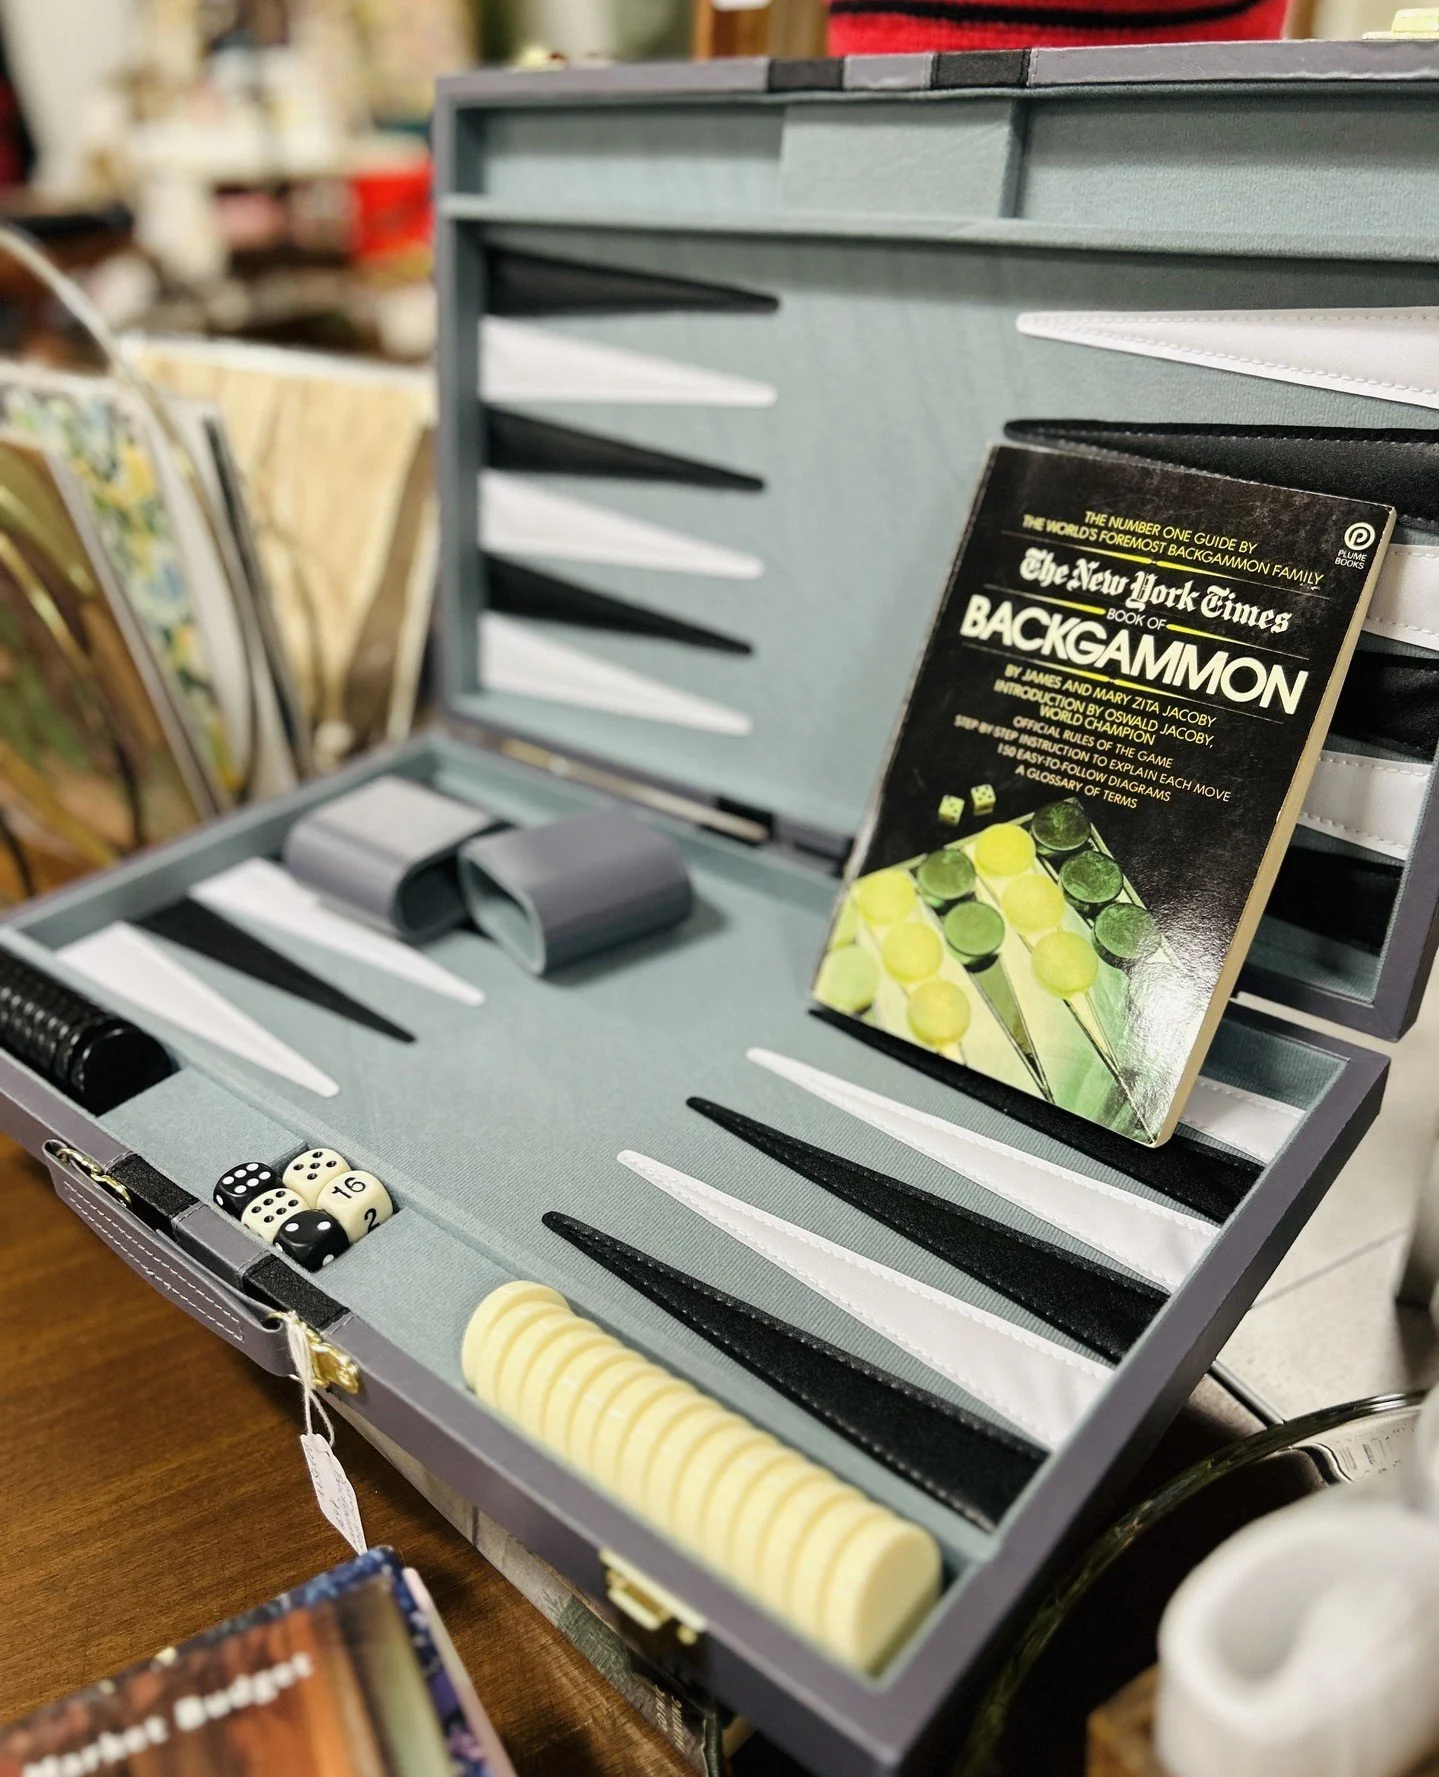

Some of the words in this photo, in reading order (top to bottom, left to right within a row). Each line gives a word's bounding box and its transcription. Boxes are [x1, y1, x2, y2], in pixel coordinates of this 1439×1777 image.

[1022, 514, 1046, 531] THE
[1046, 519, 1098, 542] WORLD'S
[1099, 530, 1167, 554] FOREMOST
[1168, 544, 1271, 576] BACKGAMMON
[1272, 564, 1325, 586] FAMILY
[1084, 511, 1107, 527] THE
[1108, 516, 1161, 536] NUMBER
[1163, 526, 1192, 543] ONE
[1194, 532, 1237, 551] GUIDE
[1239, 540, 1258, 554] BY
[1338, 549, 1367, 562] PLUME
[1335, 557, 1364, 570] BOOKS
[1019, 547, 1069, 587] The
[1066, 558, 1129, 596] New
[1126, 571, 1200, 613] York
[1201, 585, 1293, 633] Times
[1106, 608, 1147, 627] BOOK
[1147, 616, 1167, 630] OF
[960, 594, 1309, 715] BACKGAMMON
[993, 679, 1086, 713] INTRODUCTION
[1086, 703, 1104, 717] BY
[1105, 708, 1158, 732] OSWALD
[1160, 723, 1215, 749] JACOBY,
[1004, 663, 1023, 678] BY
[1021, 668, 1062, 689] JAMES
[1062, 679, 1092, 696] AND
[1093, 687, 1132, 706] MARY
[1132, 697, 1159, 714] ZITA
[1162, 706, 1217, 728] JACOBY
[1012, 715, 1060, 738] OFFICIAL
[1062, 729, 1095, 747] RULES
[1096, 739, 1113, 751] OF
[1115, 743, 1135, 758] THE
[1137, 750, 1173, 769] GAME
[1039, 704, 1083, 726] WORLD
[1084, 717, 1156, 746] CHAMPION
[953, 714, 980, 731] STEP
[977, 721, 994, 735] BY
[992, 726, 1019, 741] STEP
[1018, 733, 1090, 762] INSTRUCTION
[1092, 753, 1107, 767] TO
[1109, 759, 1158, 781] EXPLAIN
[1159, 773, 1192, 791] EACH
[1193, 783, 1232, 802] MOVE
[997, 742, 1017, 758] 150
[1016, 748, 1107, 783] EASY-TO-FOLLOW
[1108, 775, 1171, 802] DIAGRAMS
[1014, 764, 1025, 776] A
[1026, 768, 1083, 792] GLOSSARY
[1084, 785, 1101, 797] OF
[1103, 789, 1138, 809] TERMS
[332, 1177, 366, 1199] 16
[364, 1207, 380, 1233] 2
